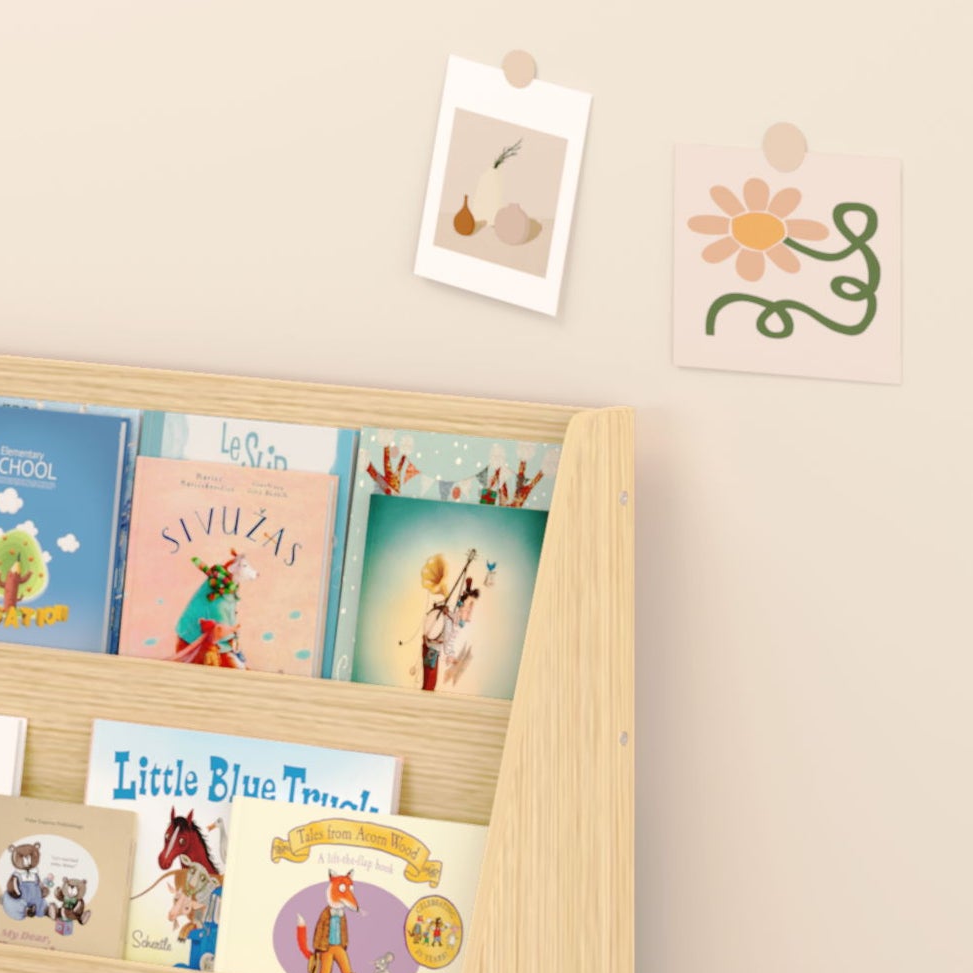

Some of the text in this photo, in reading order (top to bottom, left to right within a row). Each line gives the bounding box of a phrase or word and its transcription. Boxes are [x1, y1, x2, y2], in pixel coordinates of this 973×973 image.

[0, 445, 45, 462] Elementary
[161, 506, 303, 567] SIVUŽAS
[113, 750, 199, 801] Little
[208, 755, 277, 804] Blue
[296, 824, 420, 860] Tales from Acorn Wood
